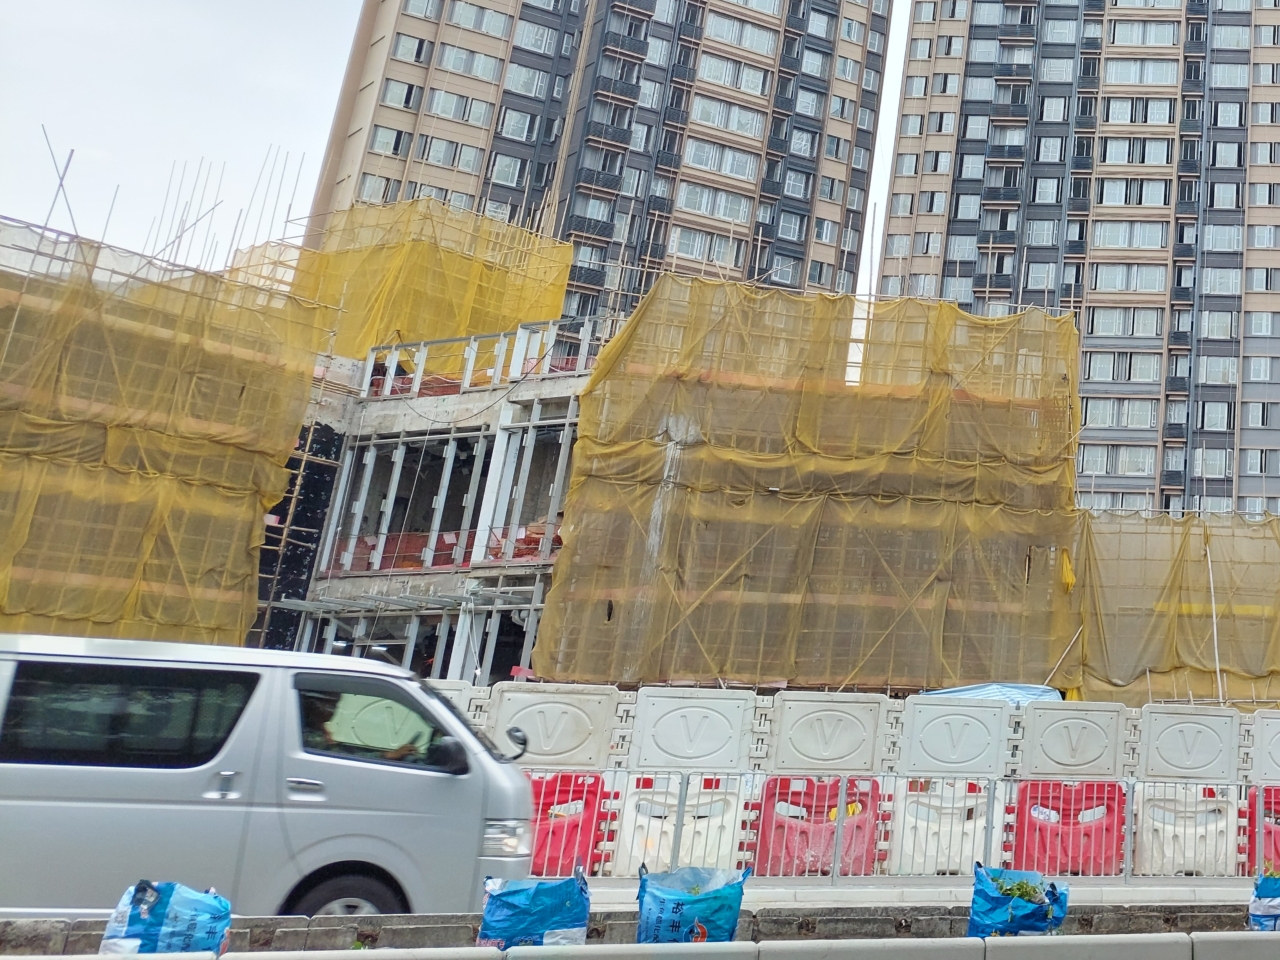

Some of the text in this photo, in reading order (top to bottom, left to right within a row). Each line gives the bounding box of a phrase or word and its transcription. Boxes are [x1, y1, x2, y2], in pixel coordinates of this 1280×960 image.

[536, 710, 569, 751] V
[680, 715, 710, 753] V
[815, 718, 844, 756] V
[944, 722, 970, 759] V
[1062, 726, 1088, 762] V
[1178, 729, 1203, 765] V
